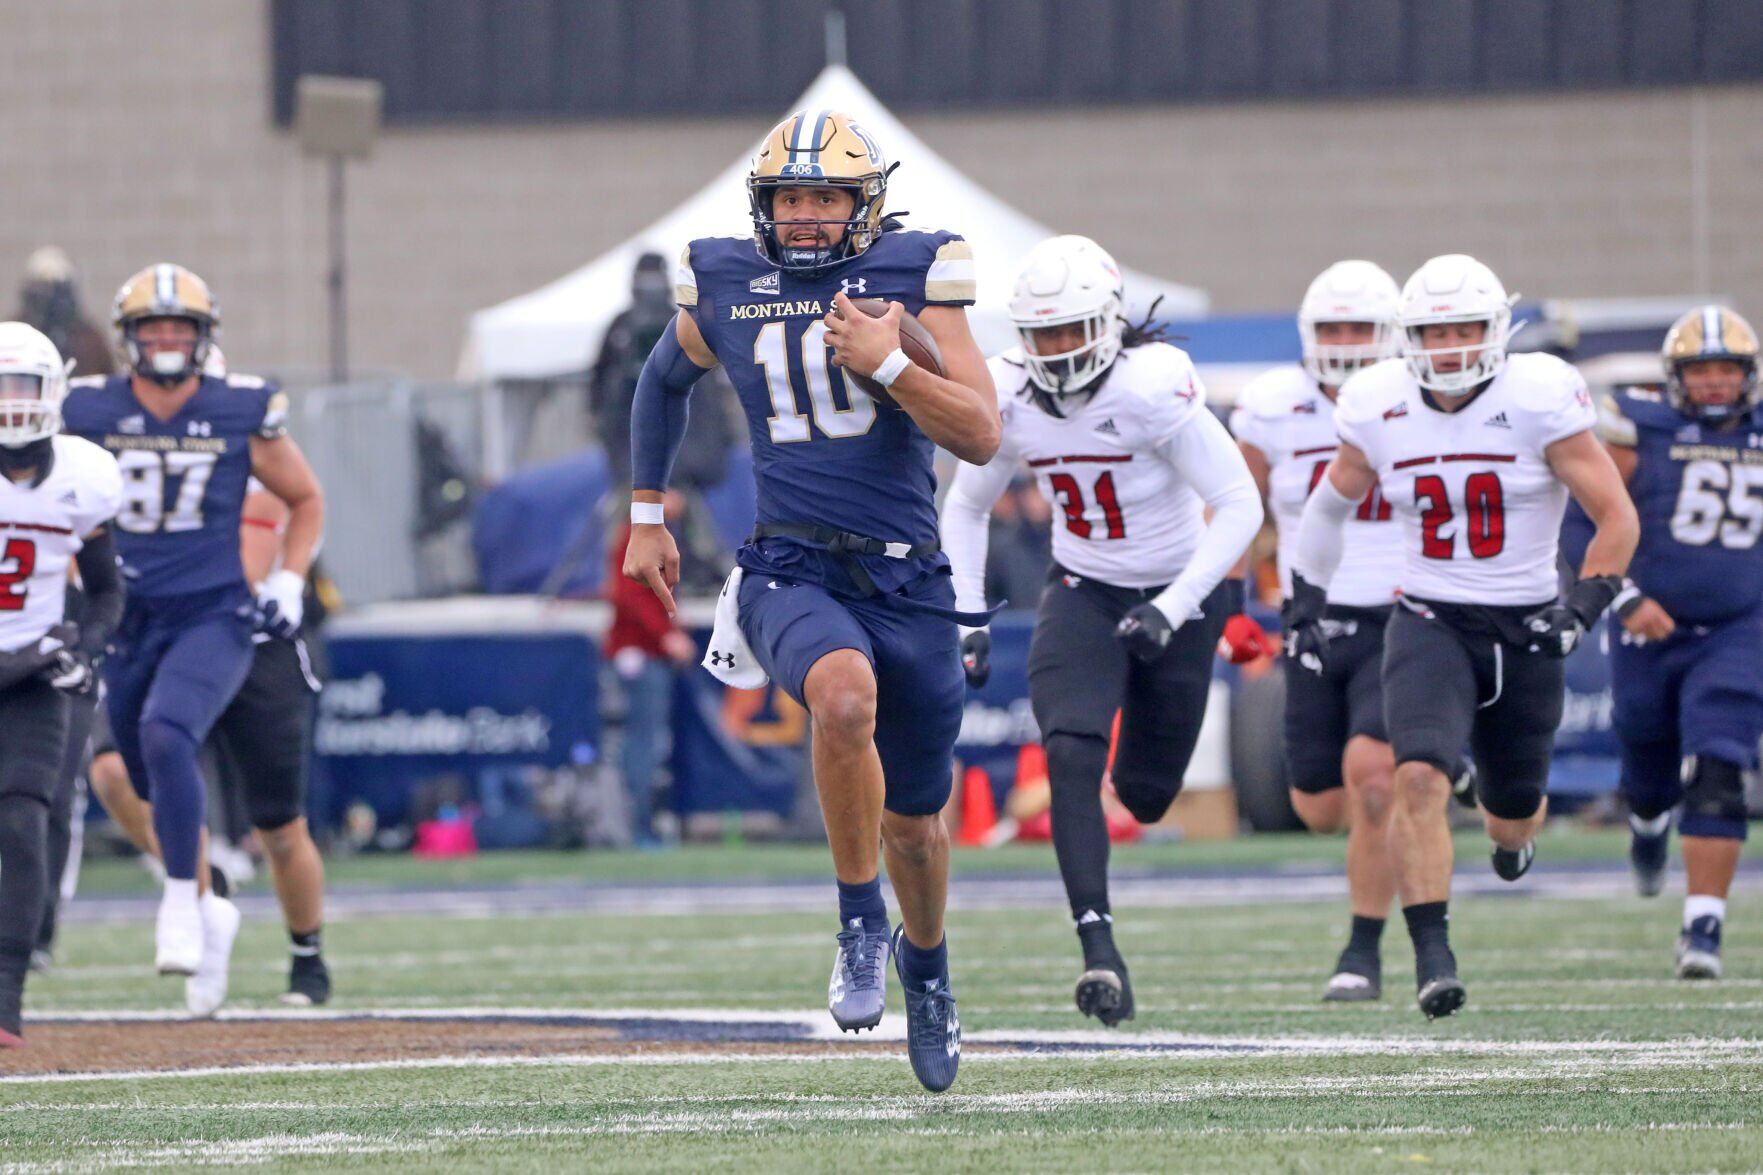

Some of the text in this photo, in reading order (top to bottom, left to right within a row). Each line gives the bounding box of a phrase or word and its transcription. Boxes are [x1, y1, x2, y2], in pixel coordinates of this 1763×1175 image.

[790, 164, 812, 175] 406
[730, 300, 822, 320] MONTANA
[754, 321, 877, 443] 10
[115, 449, 217, 533] 87
[1414, 471, 1505, 560] 20
[1670, 459, 1763, 550] 65
[0, 538, 36, 611] 2
